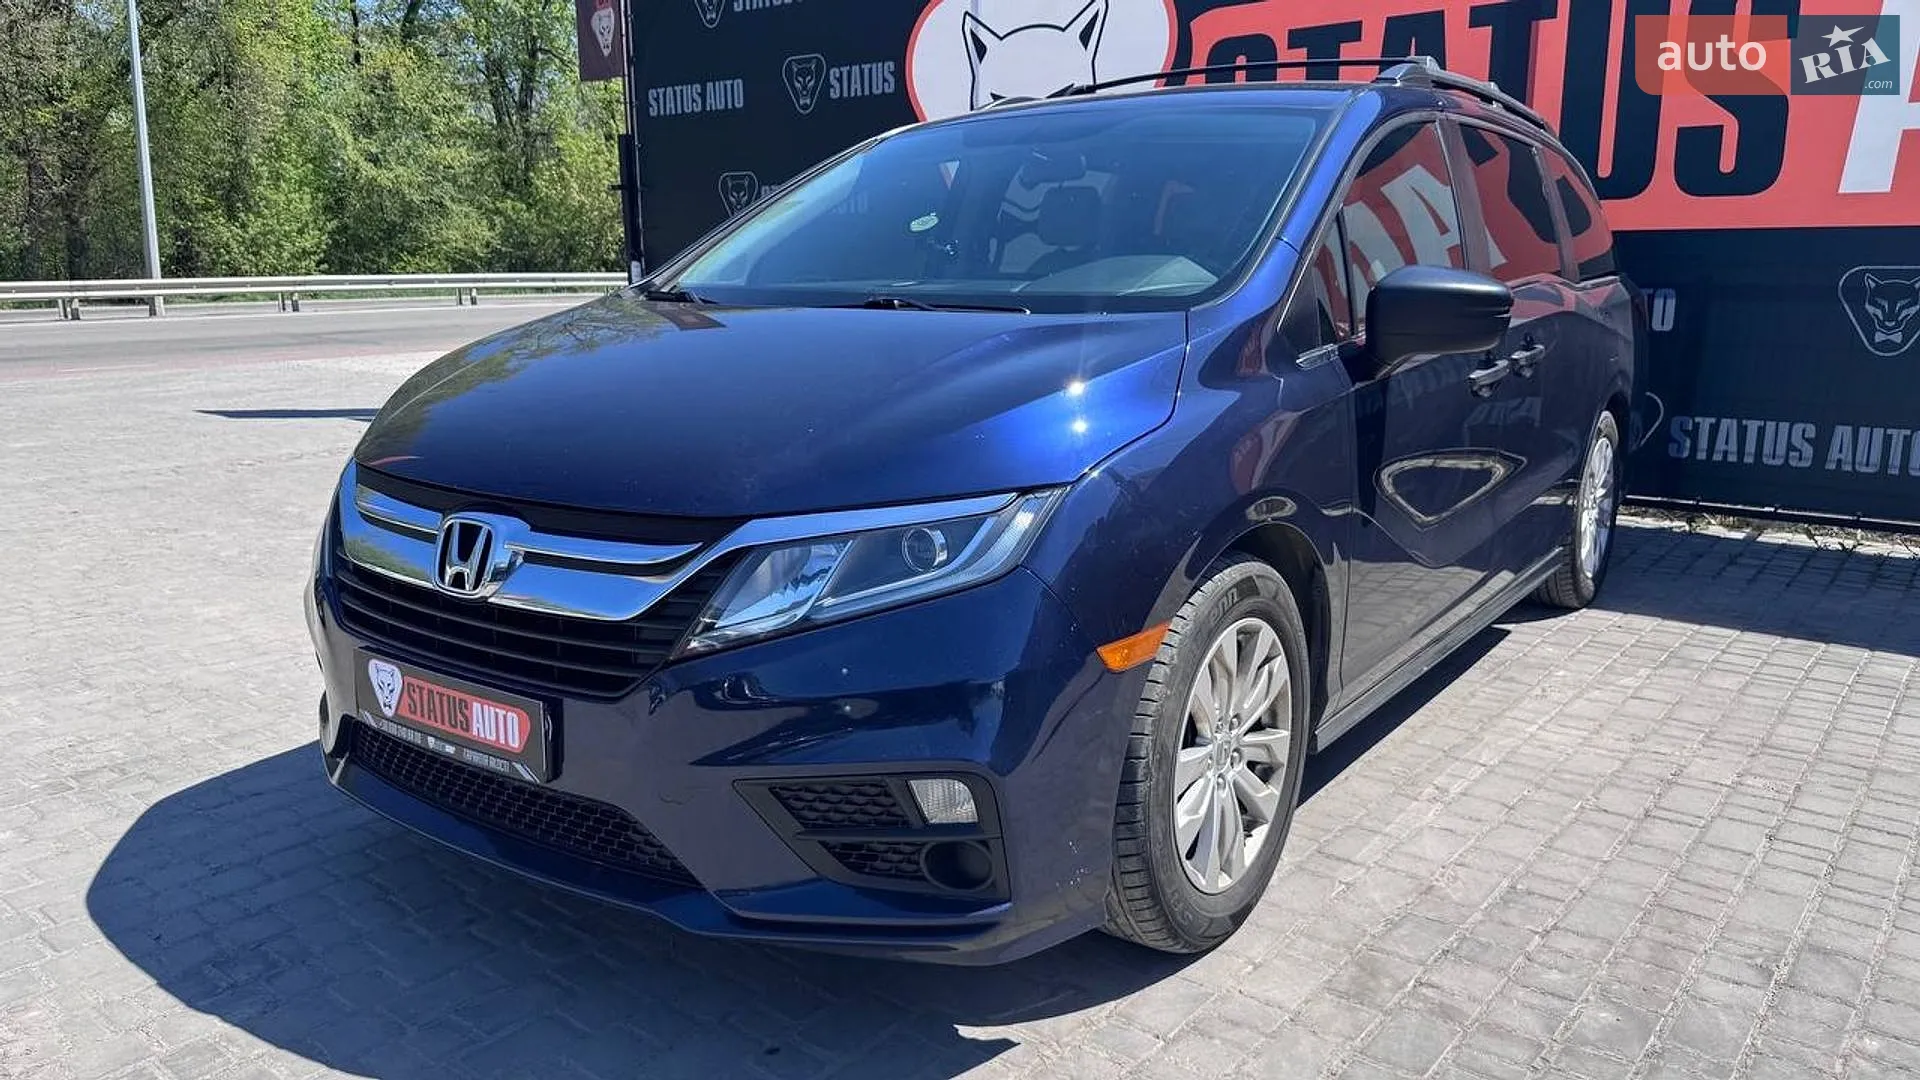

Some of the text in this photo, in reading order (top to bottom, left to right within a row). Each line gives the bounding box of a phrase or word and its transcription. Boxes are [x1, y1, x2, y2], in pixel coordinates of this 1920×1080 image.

[648, 79, 744, 116] STATUS AUTO
[829, 61, 895, 99] STATUS
[1668, 416, 1816, 468] STATUS
[406, 682, 470, 733] STATUS
[472, 702, 520, 749] AUTO
